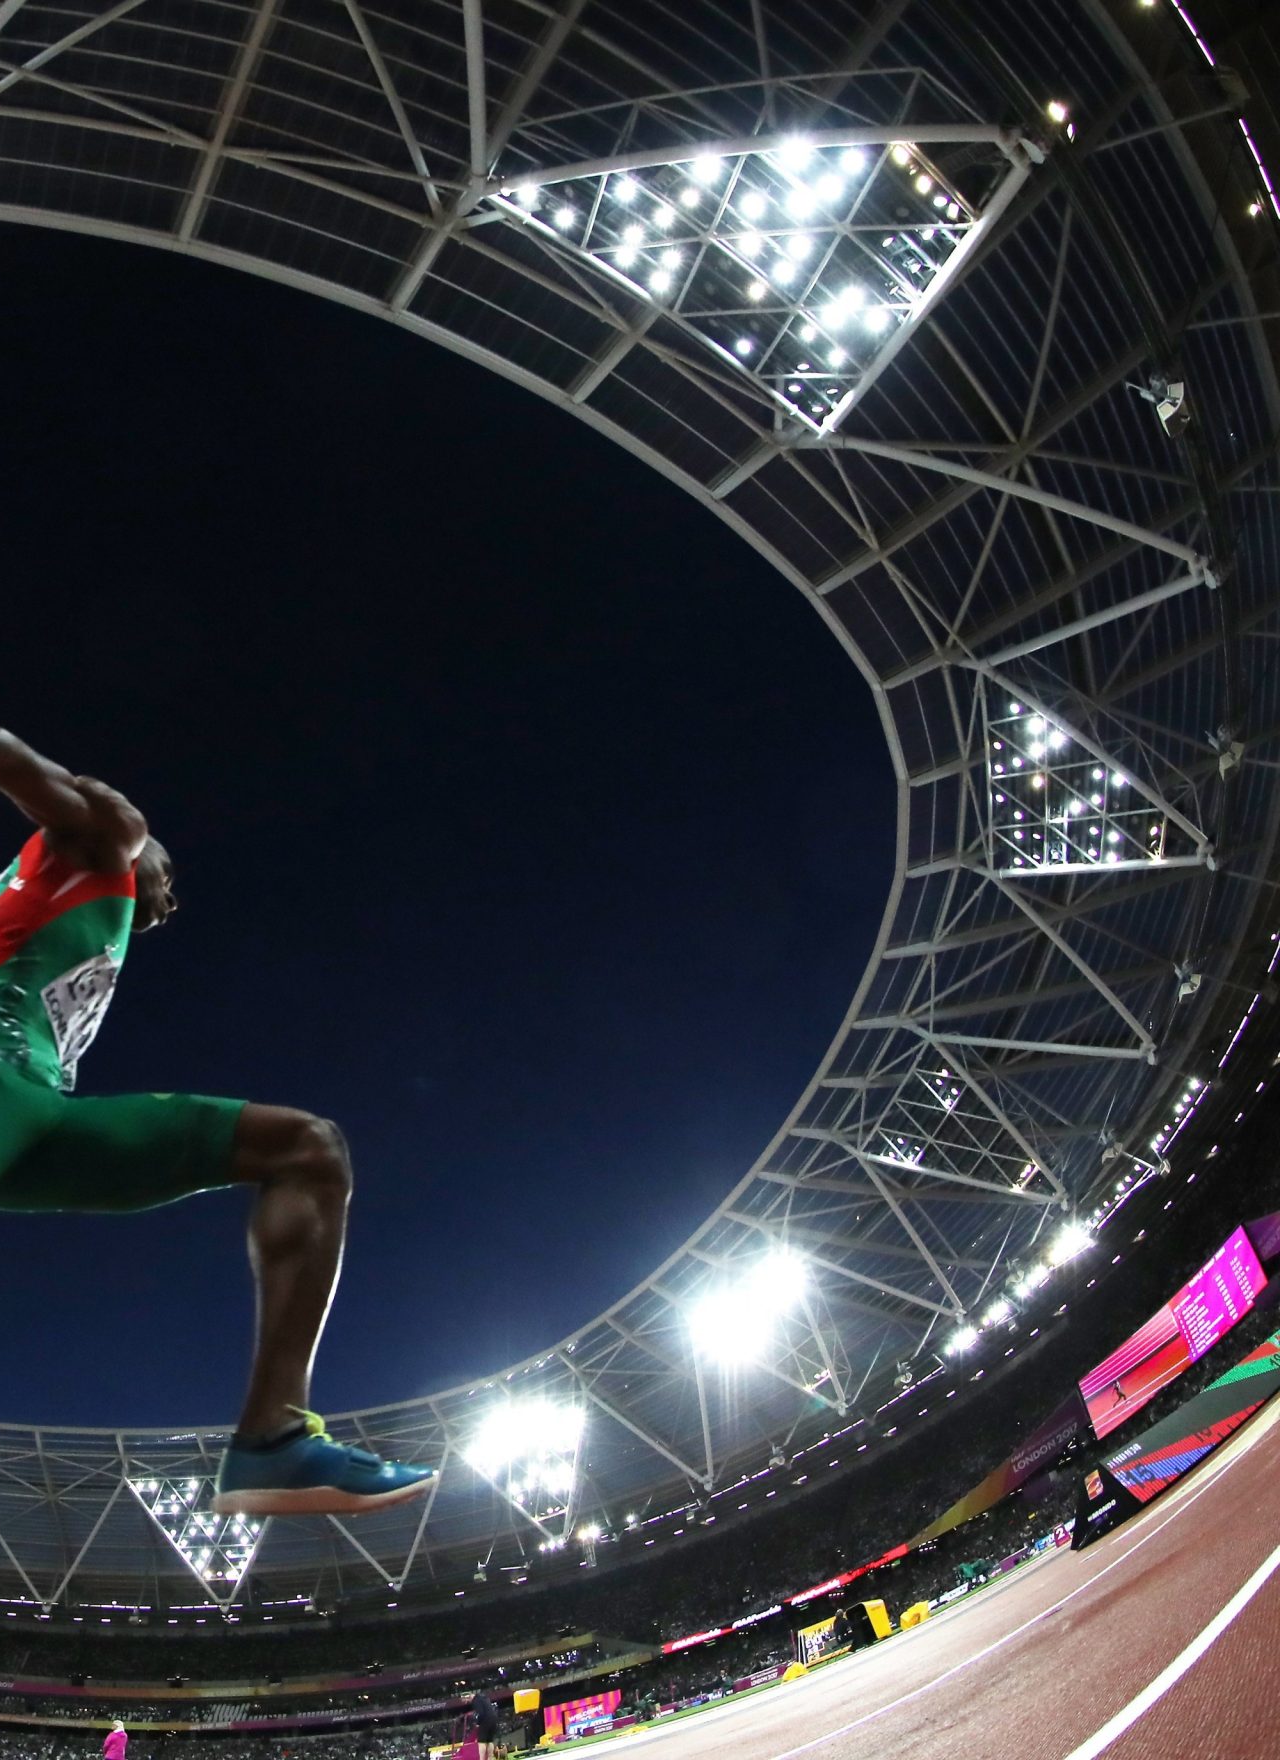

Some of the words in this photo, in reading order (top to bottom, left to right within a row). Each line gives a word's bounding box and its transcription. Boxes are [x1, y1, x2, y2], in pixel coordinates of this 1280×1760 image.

[1012, 1439, 1057, 1473] LONDON
[1056, 1421, 1078, 1444] 2017
[1055, 1527, 1066, 1540] 2
[404, 1705, 430, 1714] LONDON
